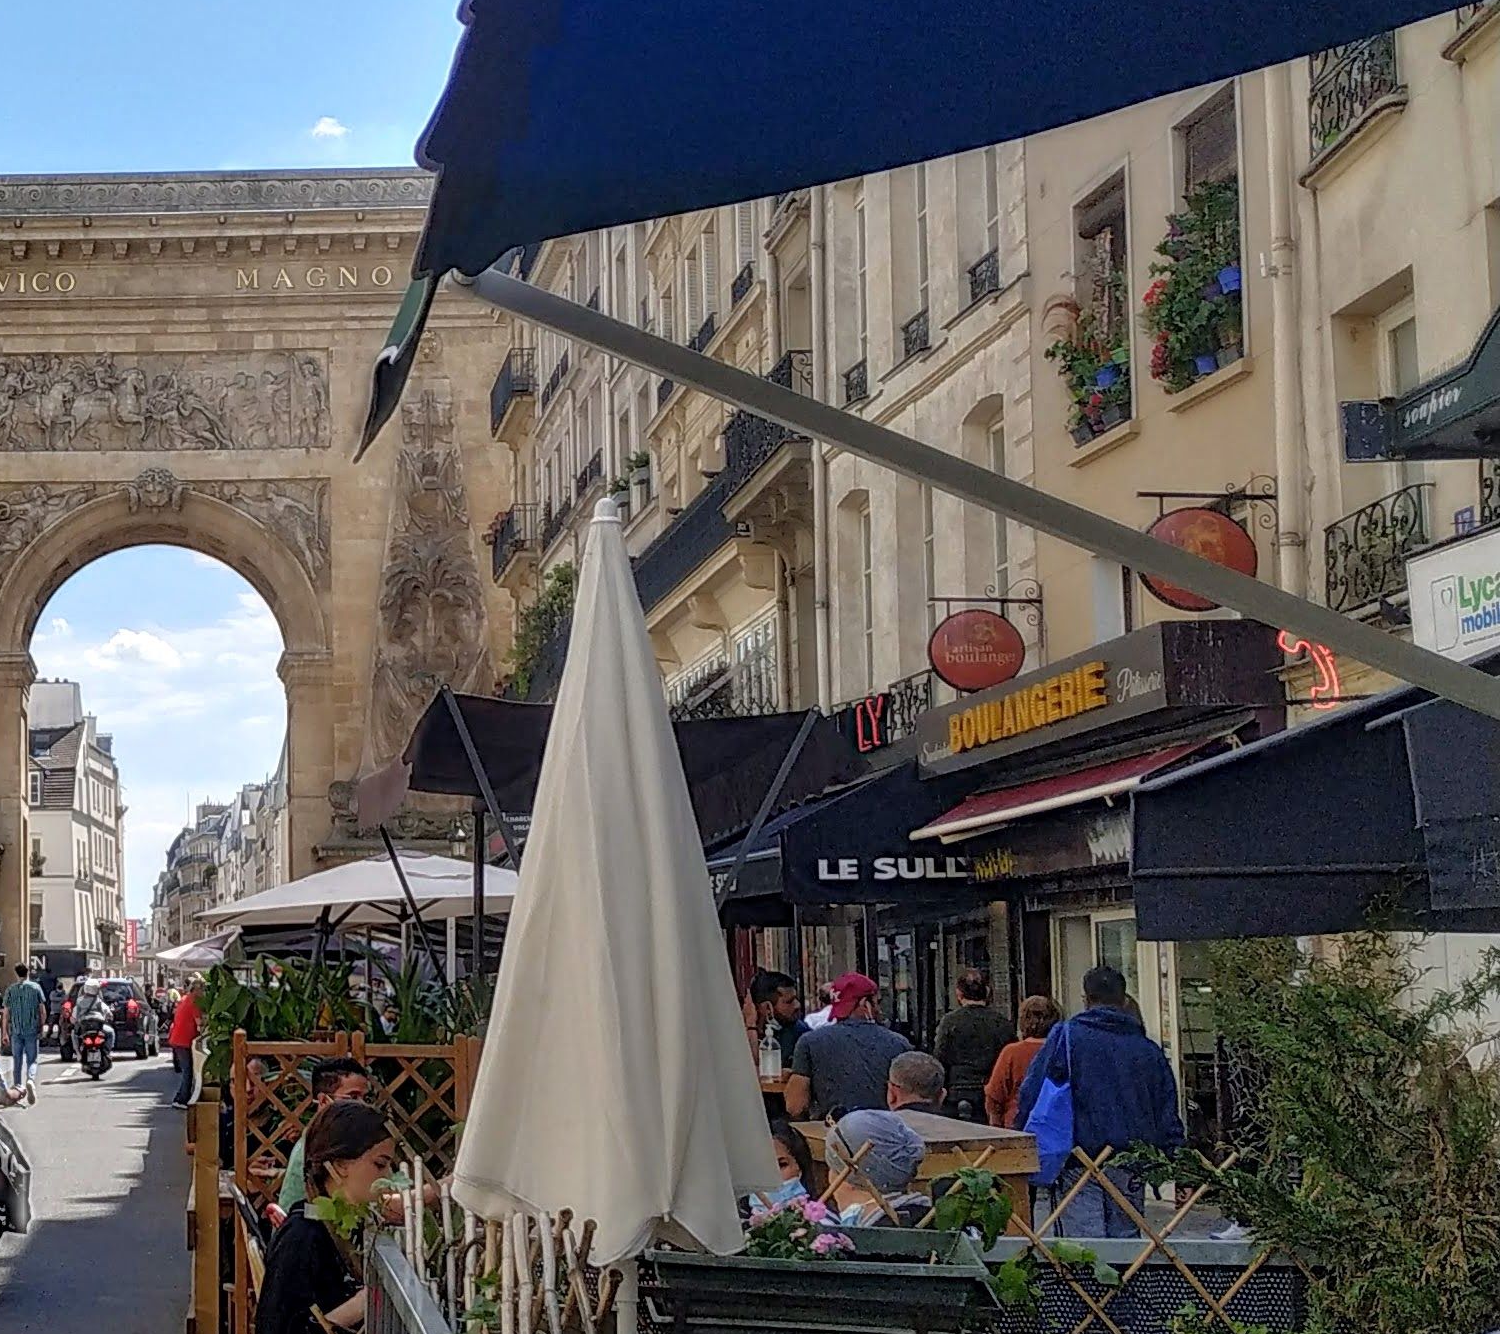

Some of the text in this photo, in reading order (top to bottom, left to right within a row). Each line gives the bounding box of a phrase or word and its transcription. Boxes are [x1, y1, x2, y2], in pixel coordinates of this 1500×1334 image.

[235, 266, 393, 290] MAGNO
[949, 662, 1108, 754] BOULANGERIE
[817, 858, 859, 880] LE
